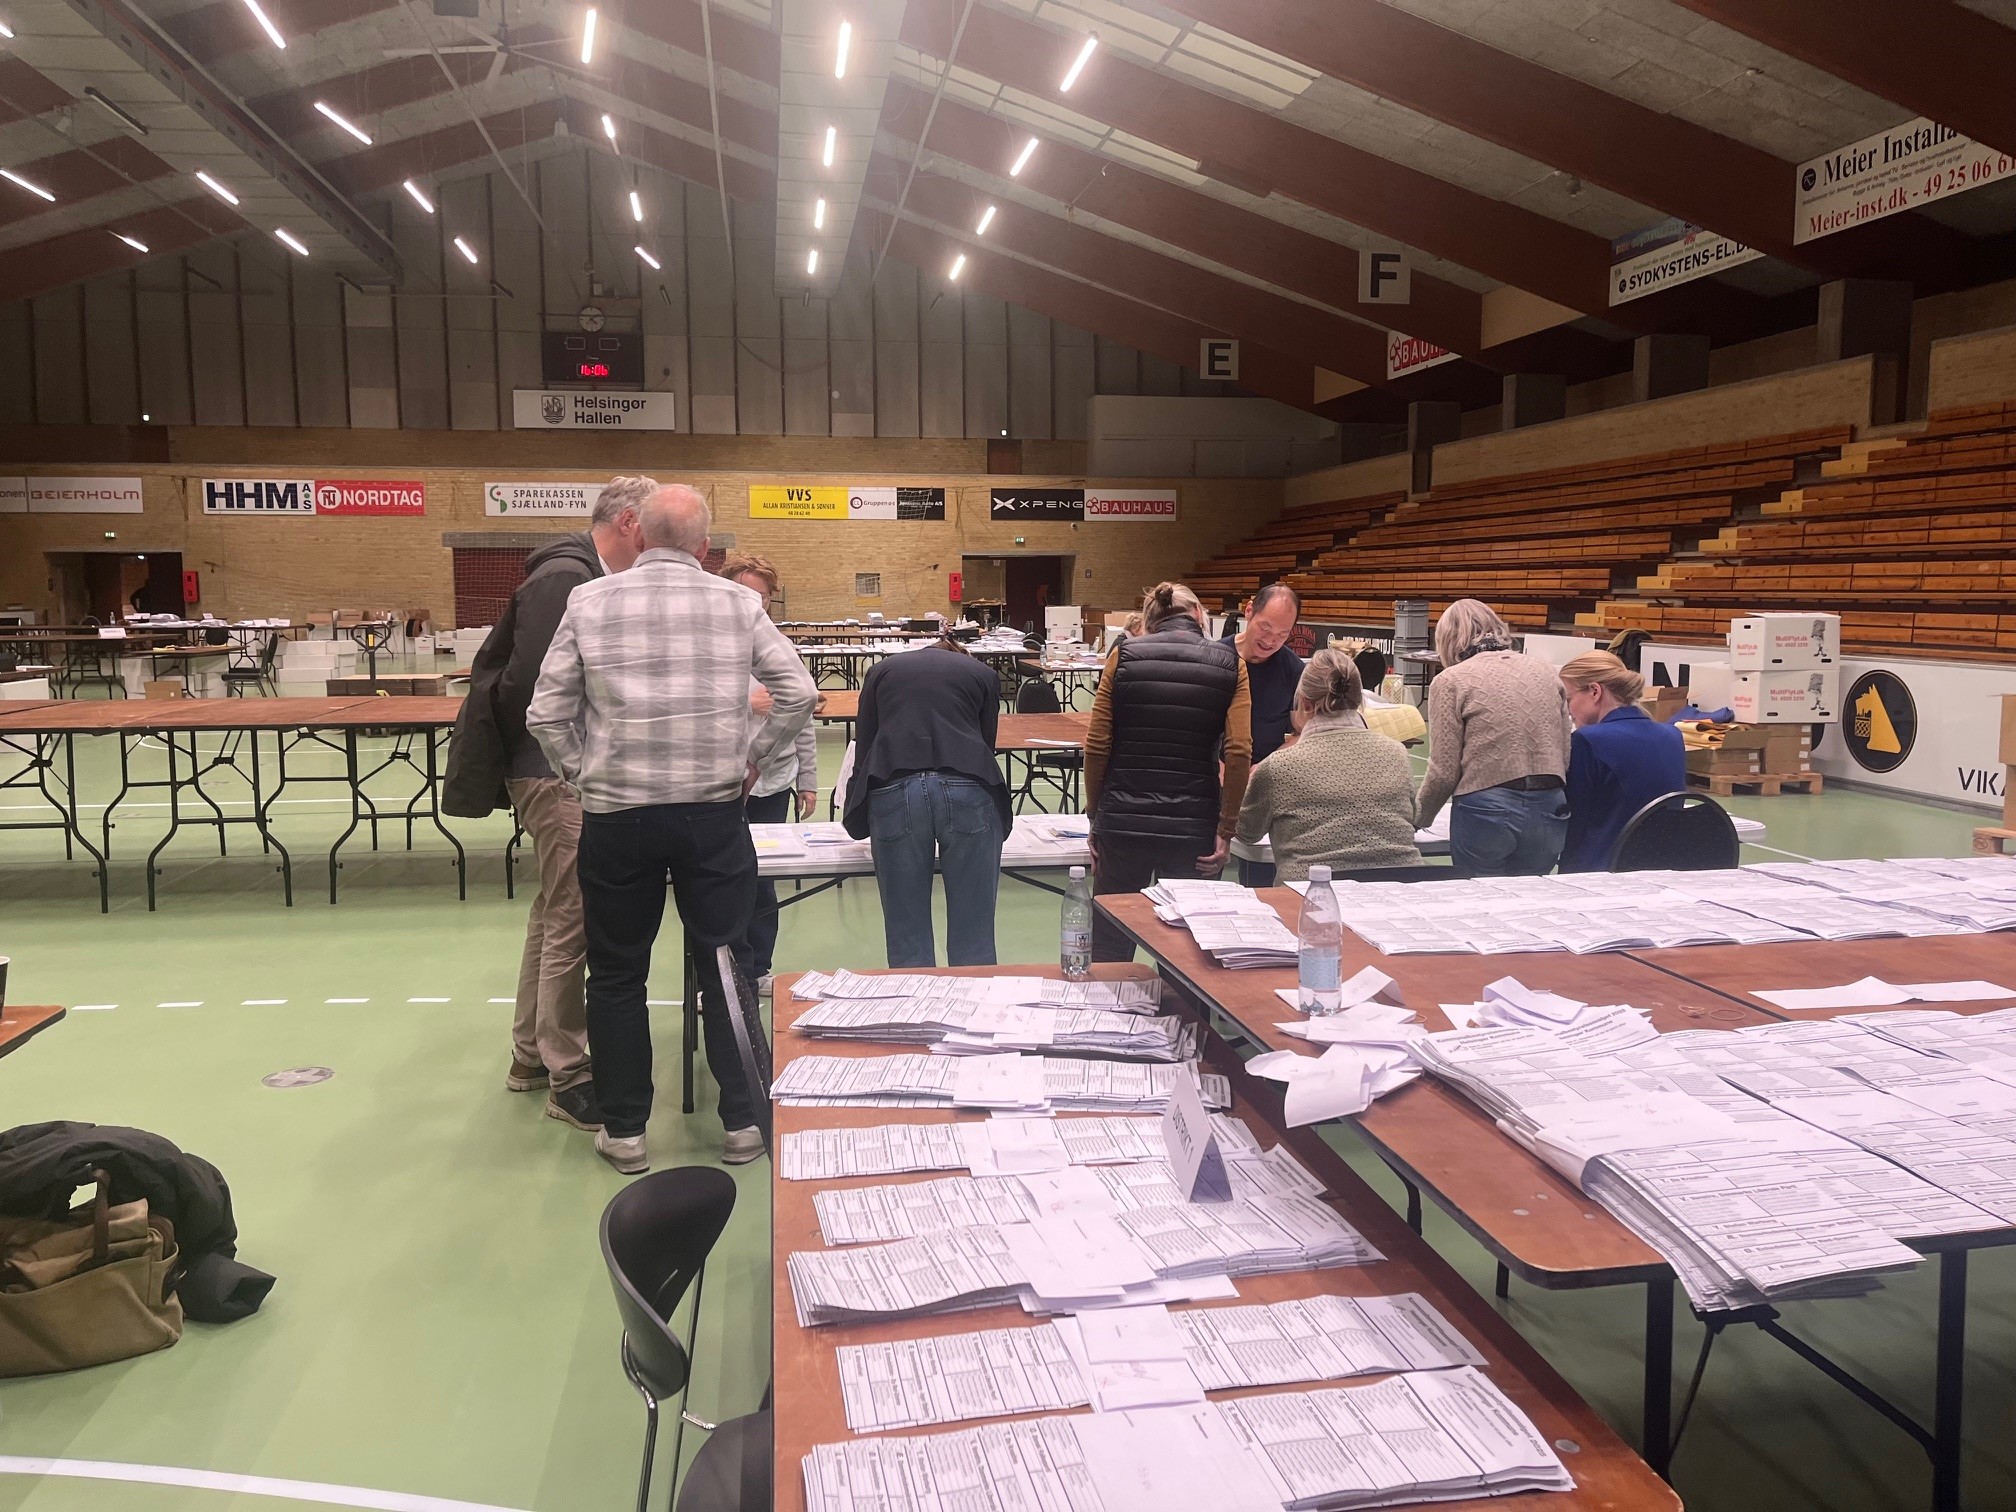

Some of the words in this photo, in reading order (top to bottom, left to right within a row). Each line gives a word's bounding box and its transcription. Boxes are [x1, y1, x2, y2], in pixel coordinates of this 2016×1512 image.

[1822, 148, 1877, 187] Meier
[1808, 186, 1908, 236] Meier-inst.dk
[1923, 173, 1943, 199] 49
[1947, 163, 1966, 191] 25
[1971, 154, 1992, 183] 06
[1629, 242, 1749, 290] SYDKYSTENS-EL.D
[1370, 253, 1401, 298] F
[1208, 342, 1231, 376] E
[580, 364, 609, 377] 16:06
[573, 396, 646, 412] Helsingør
[574, 411, 621, 424] Hallen
[31, 490, 139, 500] BEIERHOLM
[206, 482, 298, 510] HHM
[343, 489, 423, 506] NORDTAG
[513, 489, 584, 498] SPAREKASSEN
[786, 488, 812, 501] VVS
[512, 500, 587, 509] SJÆLLAND-FYN
[1019, 500, 1084, 509] XPENG
[1101, 501, 1175, 514] BAUHAUS
[1958, 766, 2006, 797] VIK
